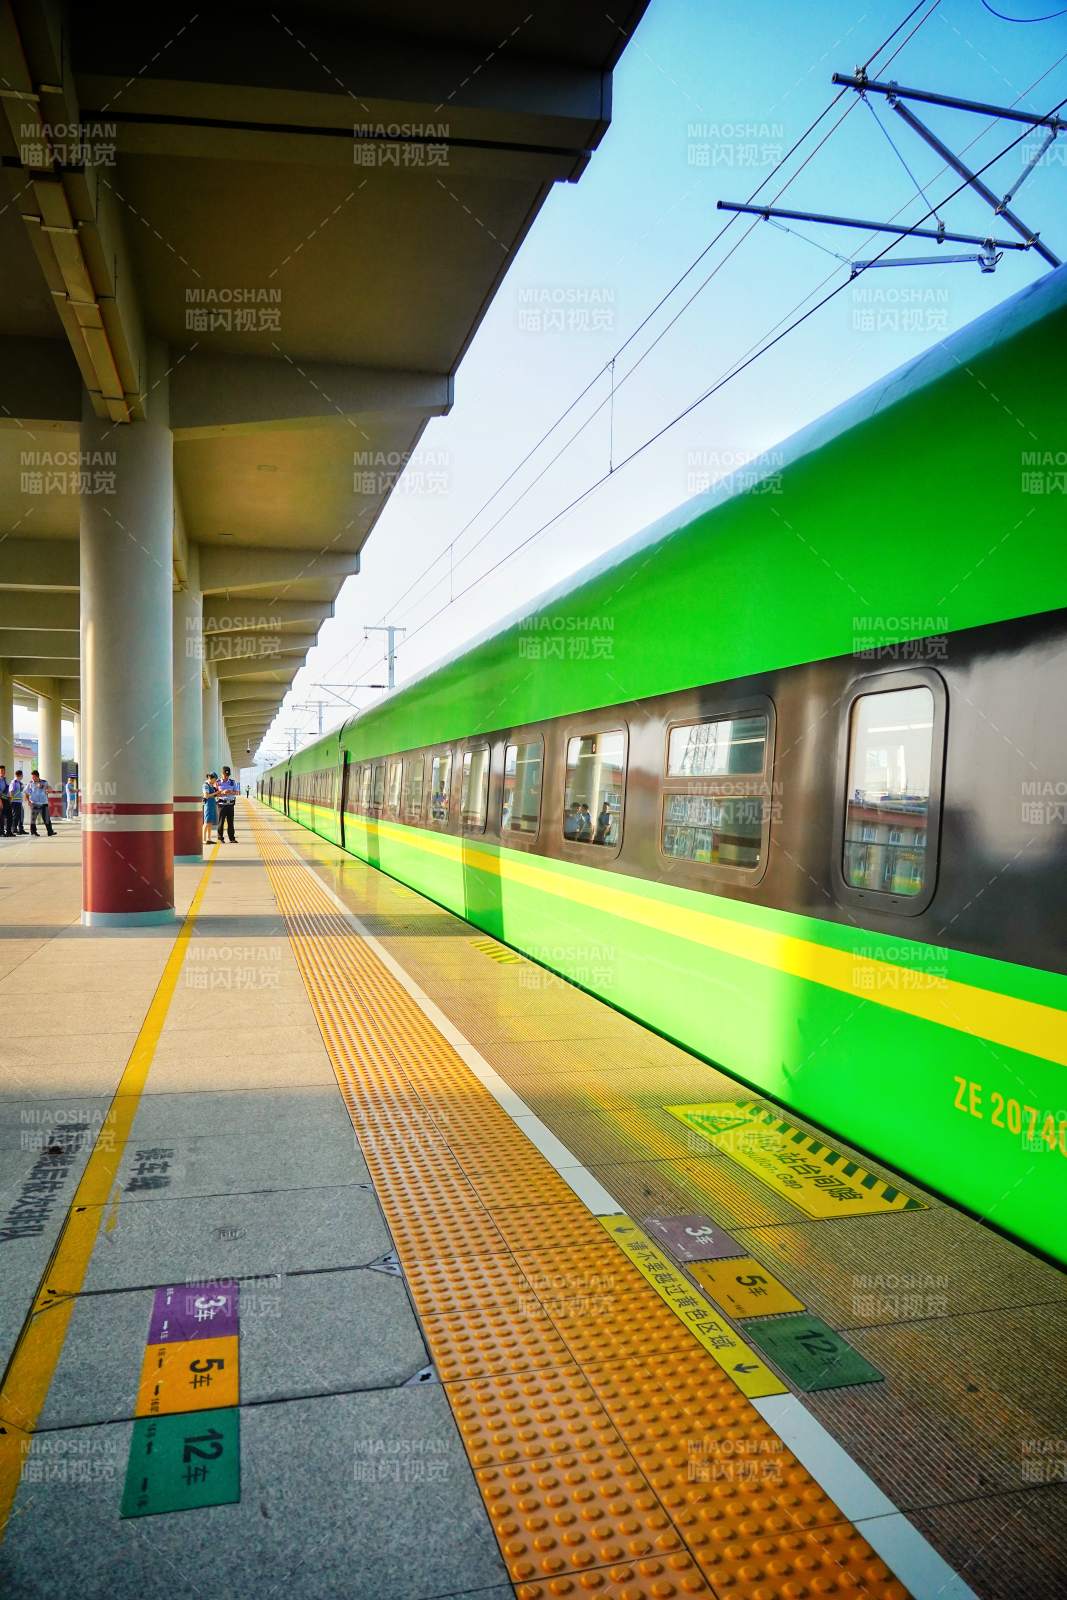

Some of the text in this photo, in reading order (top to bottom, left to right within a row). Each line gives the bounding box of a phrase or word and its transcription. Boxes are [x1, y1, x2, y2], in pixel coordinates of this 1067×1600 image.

[954, 1075, 983, 1119] ZE
[685, 1226, 714, 1246] 3车
[628, 1240, 737, 1350] 请不要越过黄色区域
[736, 1274, 768, 1297] 5车
[194, 1295, 227, 1322] 3车
[794, 1329, 842, 1368] 12车
[189, 1358, 225, 1389] 5车
[182, 1428, 224, 1486] 12车
